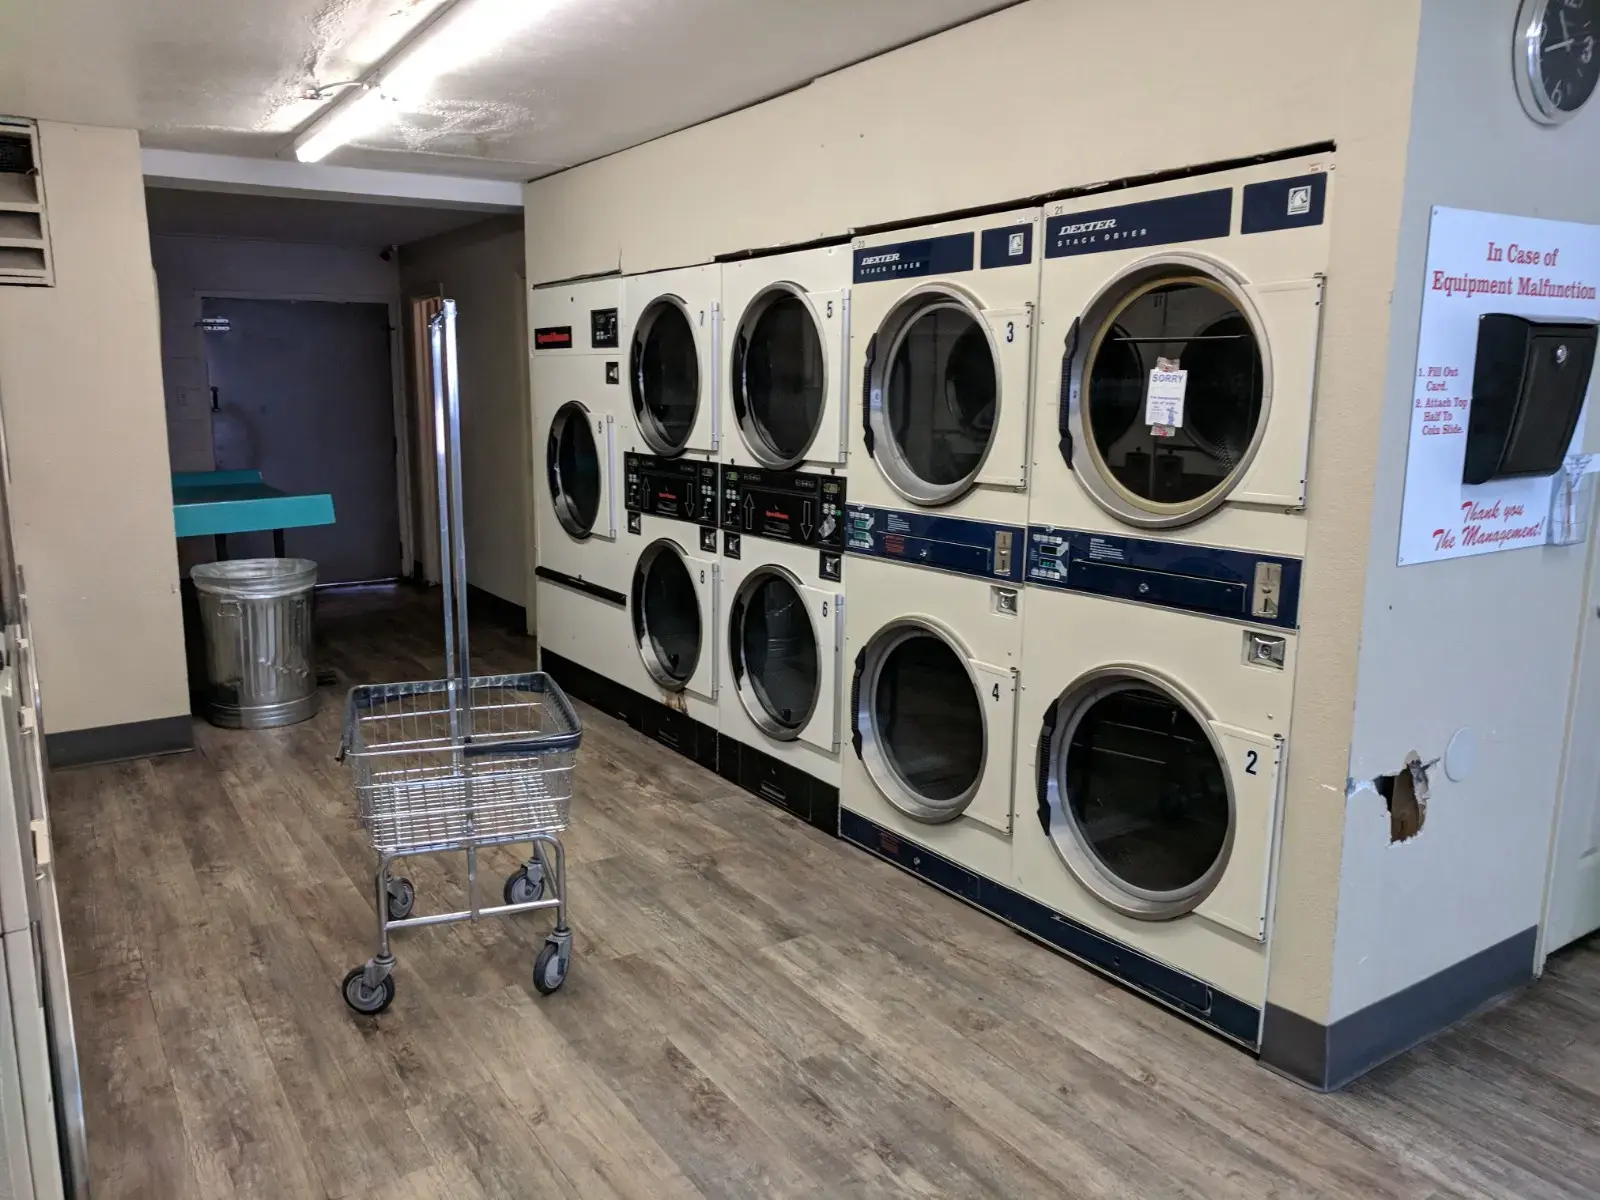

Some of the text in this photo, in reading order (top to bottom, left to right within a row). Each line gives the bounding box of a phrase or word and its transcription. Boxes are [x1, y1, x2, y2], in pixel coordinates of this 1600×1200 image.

[1581, 35, 1594, 64] 3
[1058, 218, 1117, 236] DEXTER
[1057, 228, 1147, 247] STACK DRYER
[861, 253, 900, 266] DEXTER
[1487, 242, 1559, 267] In Case of
[860, 262, 921, 275] STACK DRYER
[1432, 270, 1596, 300] Equipment Malfunction
[699, 310, 705, 326] 7
[826, 300, 833, 319] 5
[1006, 321, 1014, 343] 3
[1152, 374, 1184, 383] SORRY
[1427, 366, 1442, 377] Fill
[1443, 366, 1459, 377] Out
[1425, 397, 1451, 408] Attach
[1453, 396, 1468, 410] Top
[1423, 410, 1453, 422] Half To
[1421, 424, 1440, 435] Coin
[1460, 499, 1525, 523] Thank you
[1432, 516, 1545, 551] The Management!
[700, 569, 705, 584] 8
[822, 601, 829, 618] 6
[991, 682, 1000, 702] 4
[1245, 750, 1258, 776] 2
